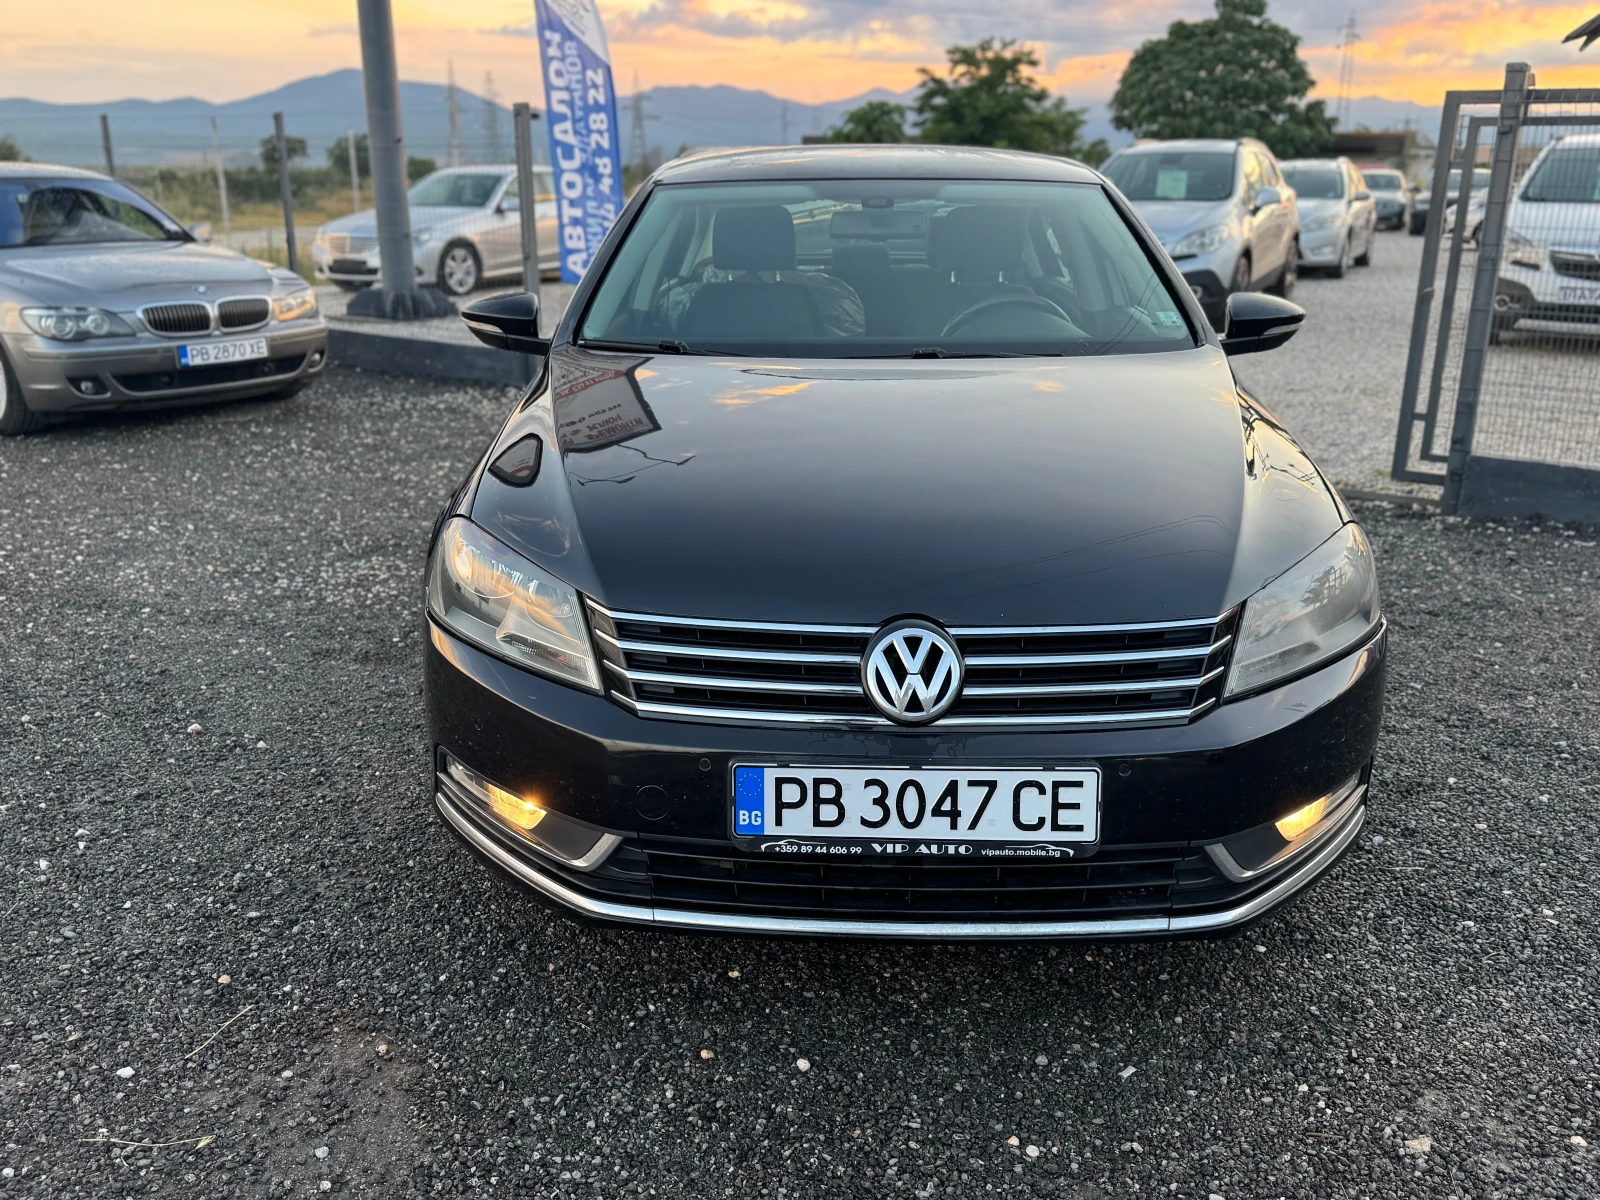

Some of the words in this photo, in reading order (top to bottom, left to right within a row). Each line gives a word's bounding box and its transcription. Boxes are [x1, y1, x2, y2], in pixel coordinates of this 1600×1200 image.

[585, 68, 606, 105] 22
[590, 112, 610, 150] 28
[544, 29, 589, 277] АВТОСАЛОН
[190, 346, 210, 363] PB
[213, 343, 246, 361] 2870
[248, 340, 265, 357] XE
[867, 628, 960, 719] VW
[739, 810, 762, 826] BG
[774, 776, 846, 828] PB
[860, 778, 998, 830] 3047
[1012, 779, 1084, 832] CE
[774, 845, 798, 853] +359
[800, 845, 813, 853] 89
[815, 845, 827, 854] 44
[829, 846, 847, 854] 606
[849, 846, 862, 855] 99
[870, 843, 910, 854] VIP
[914, 843, 973, 855] AUTO
[981, 848, 1061, 858] vipauto.mobile.bg
